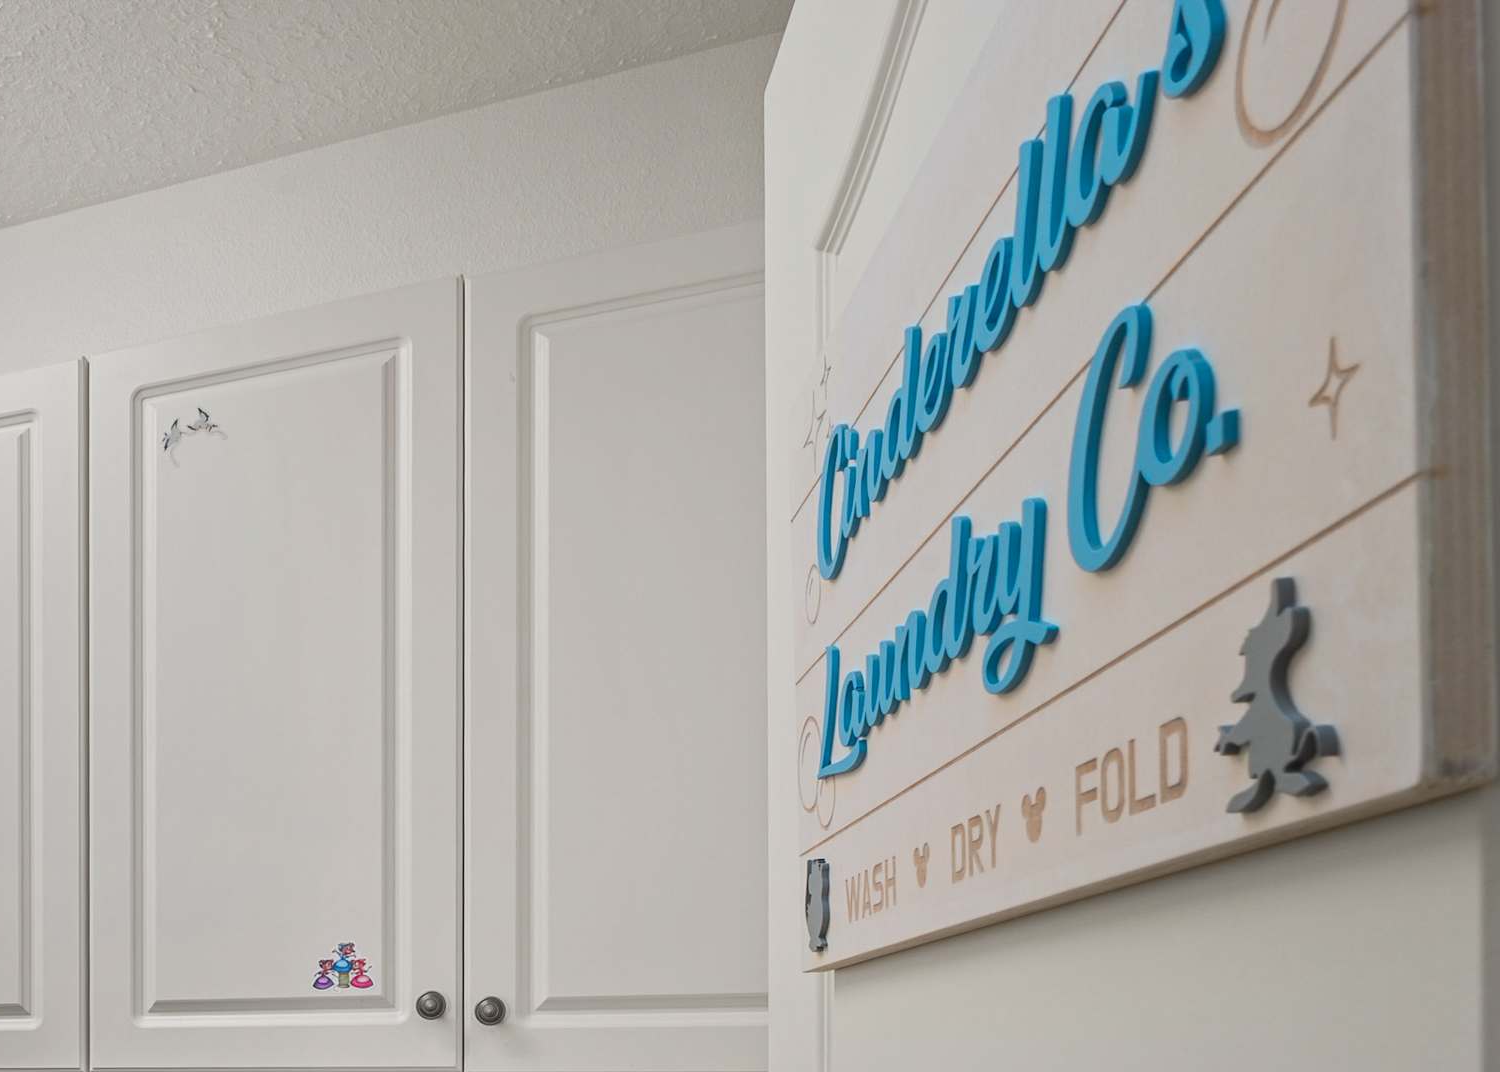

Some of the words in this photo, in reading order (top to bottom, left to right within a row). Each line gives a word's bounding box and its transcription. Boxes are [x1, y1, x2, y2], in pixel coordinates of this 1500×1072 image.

[818, 496, 1060, 780] Laundry
[1067, 301, 1242, 573] Co.
[844, 854, 898, 924] WASH
[949, 803, 1002, 884] DRY
[1074, 715, 1190, 837] FOLD
